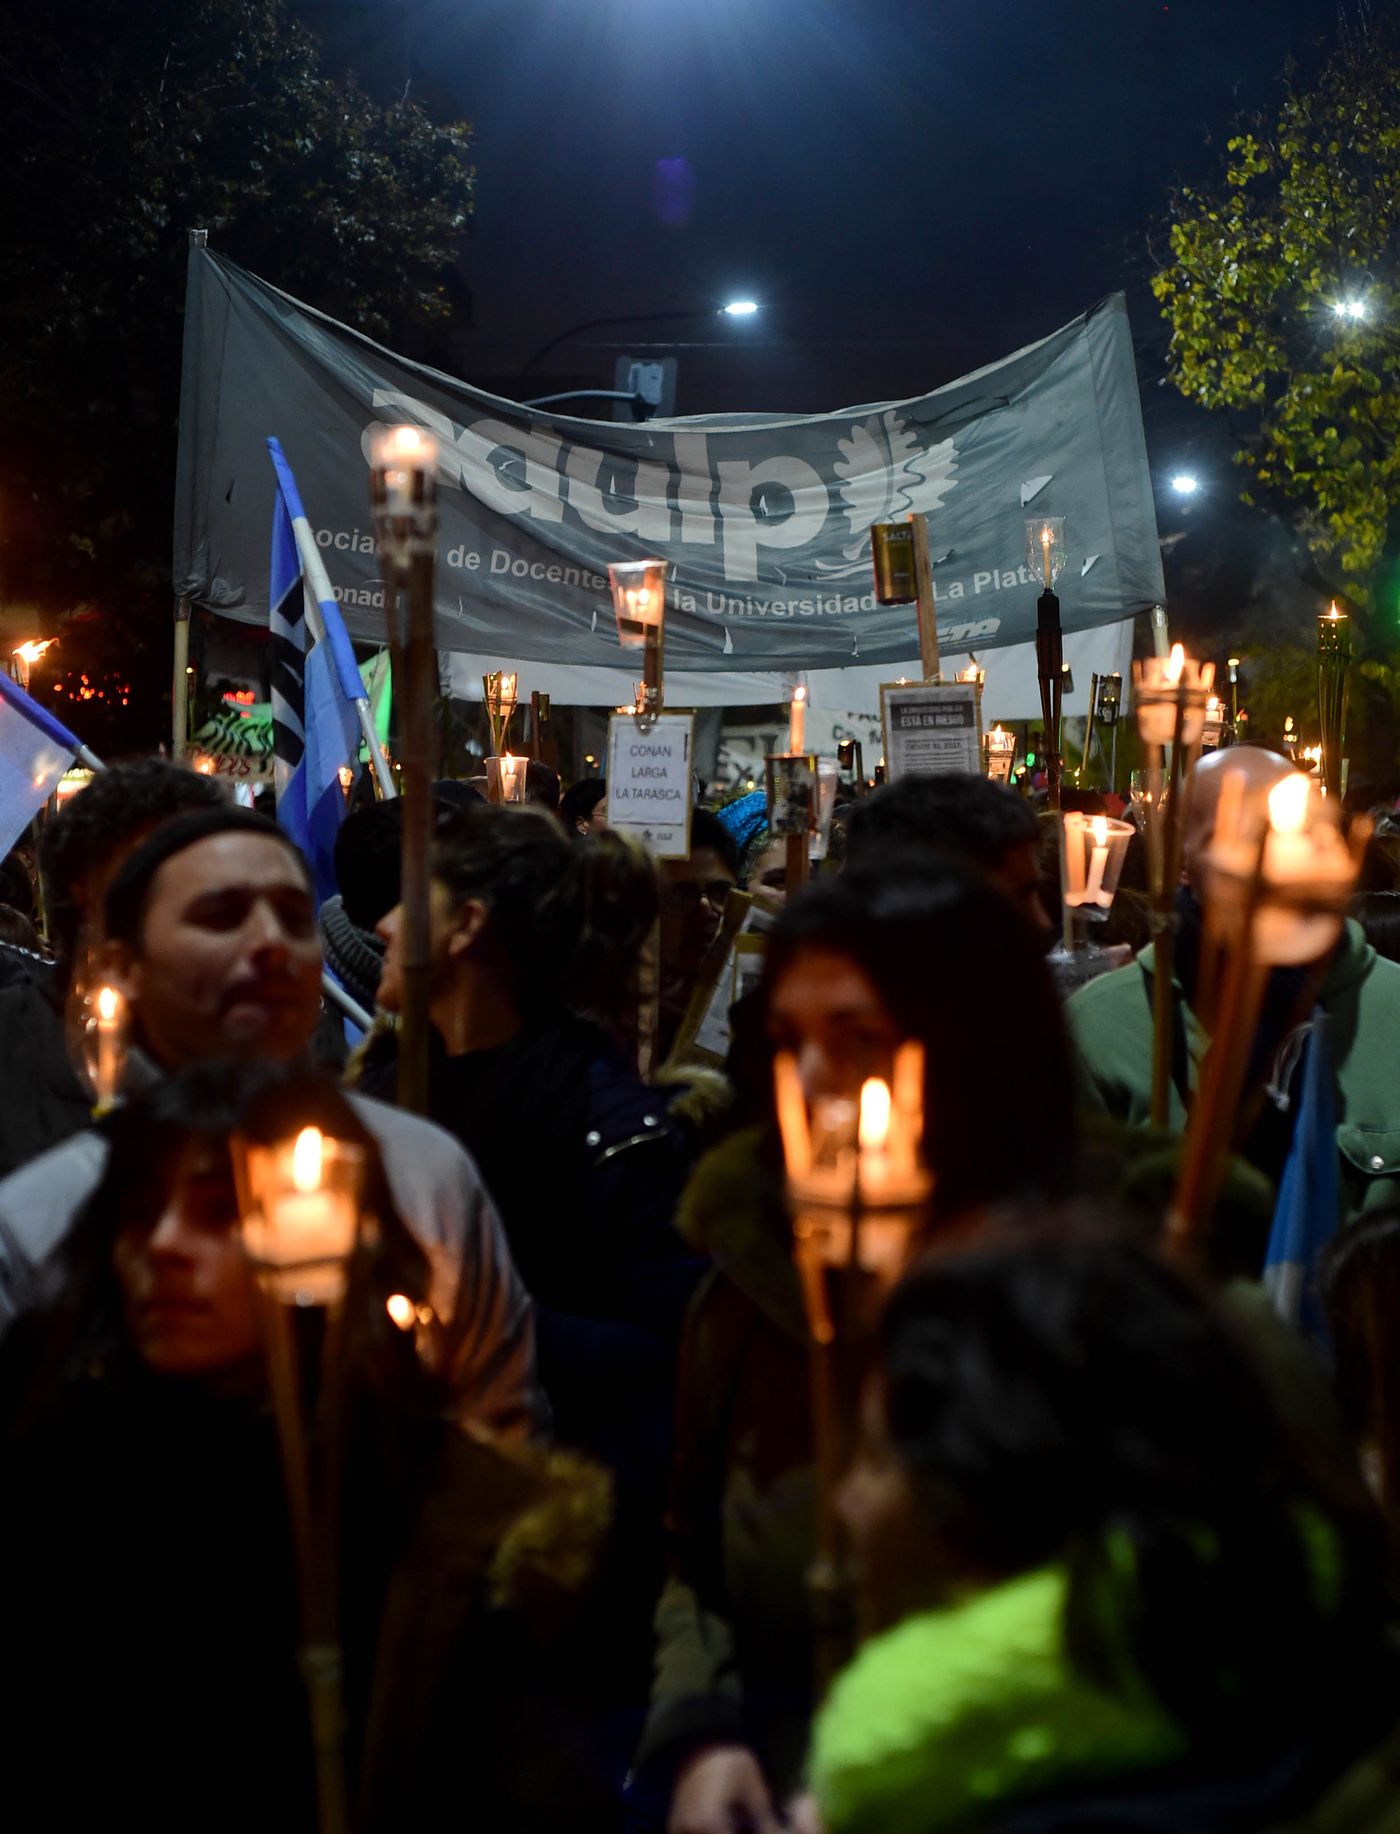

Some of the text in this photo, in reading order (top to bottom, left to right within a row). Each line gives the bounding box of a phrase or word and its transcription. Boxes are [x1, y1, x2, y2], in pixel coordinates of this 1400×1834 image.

[447, 545, 480, 570] de
[674, 589, 697, 613] la
[706, 591, 877, 617] Universidad
[933, 581, 965, 601] La
[629, 745, 672, 757] CONAN
[631, 767, 668, 779] LARGA
[616, 788, 681, 801] LA TARASCA
